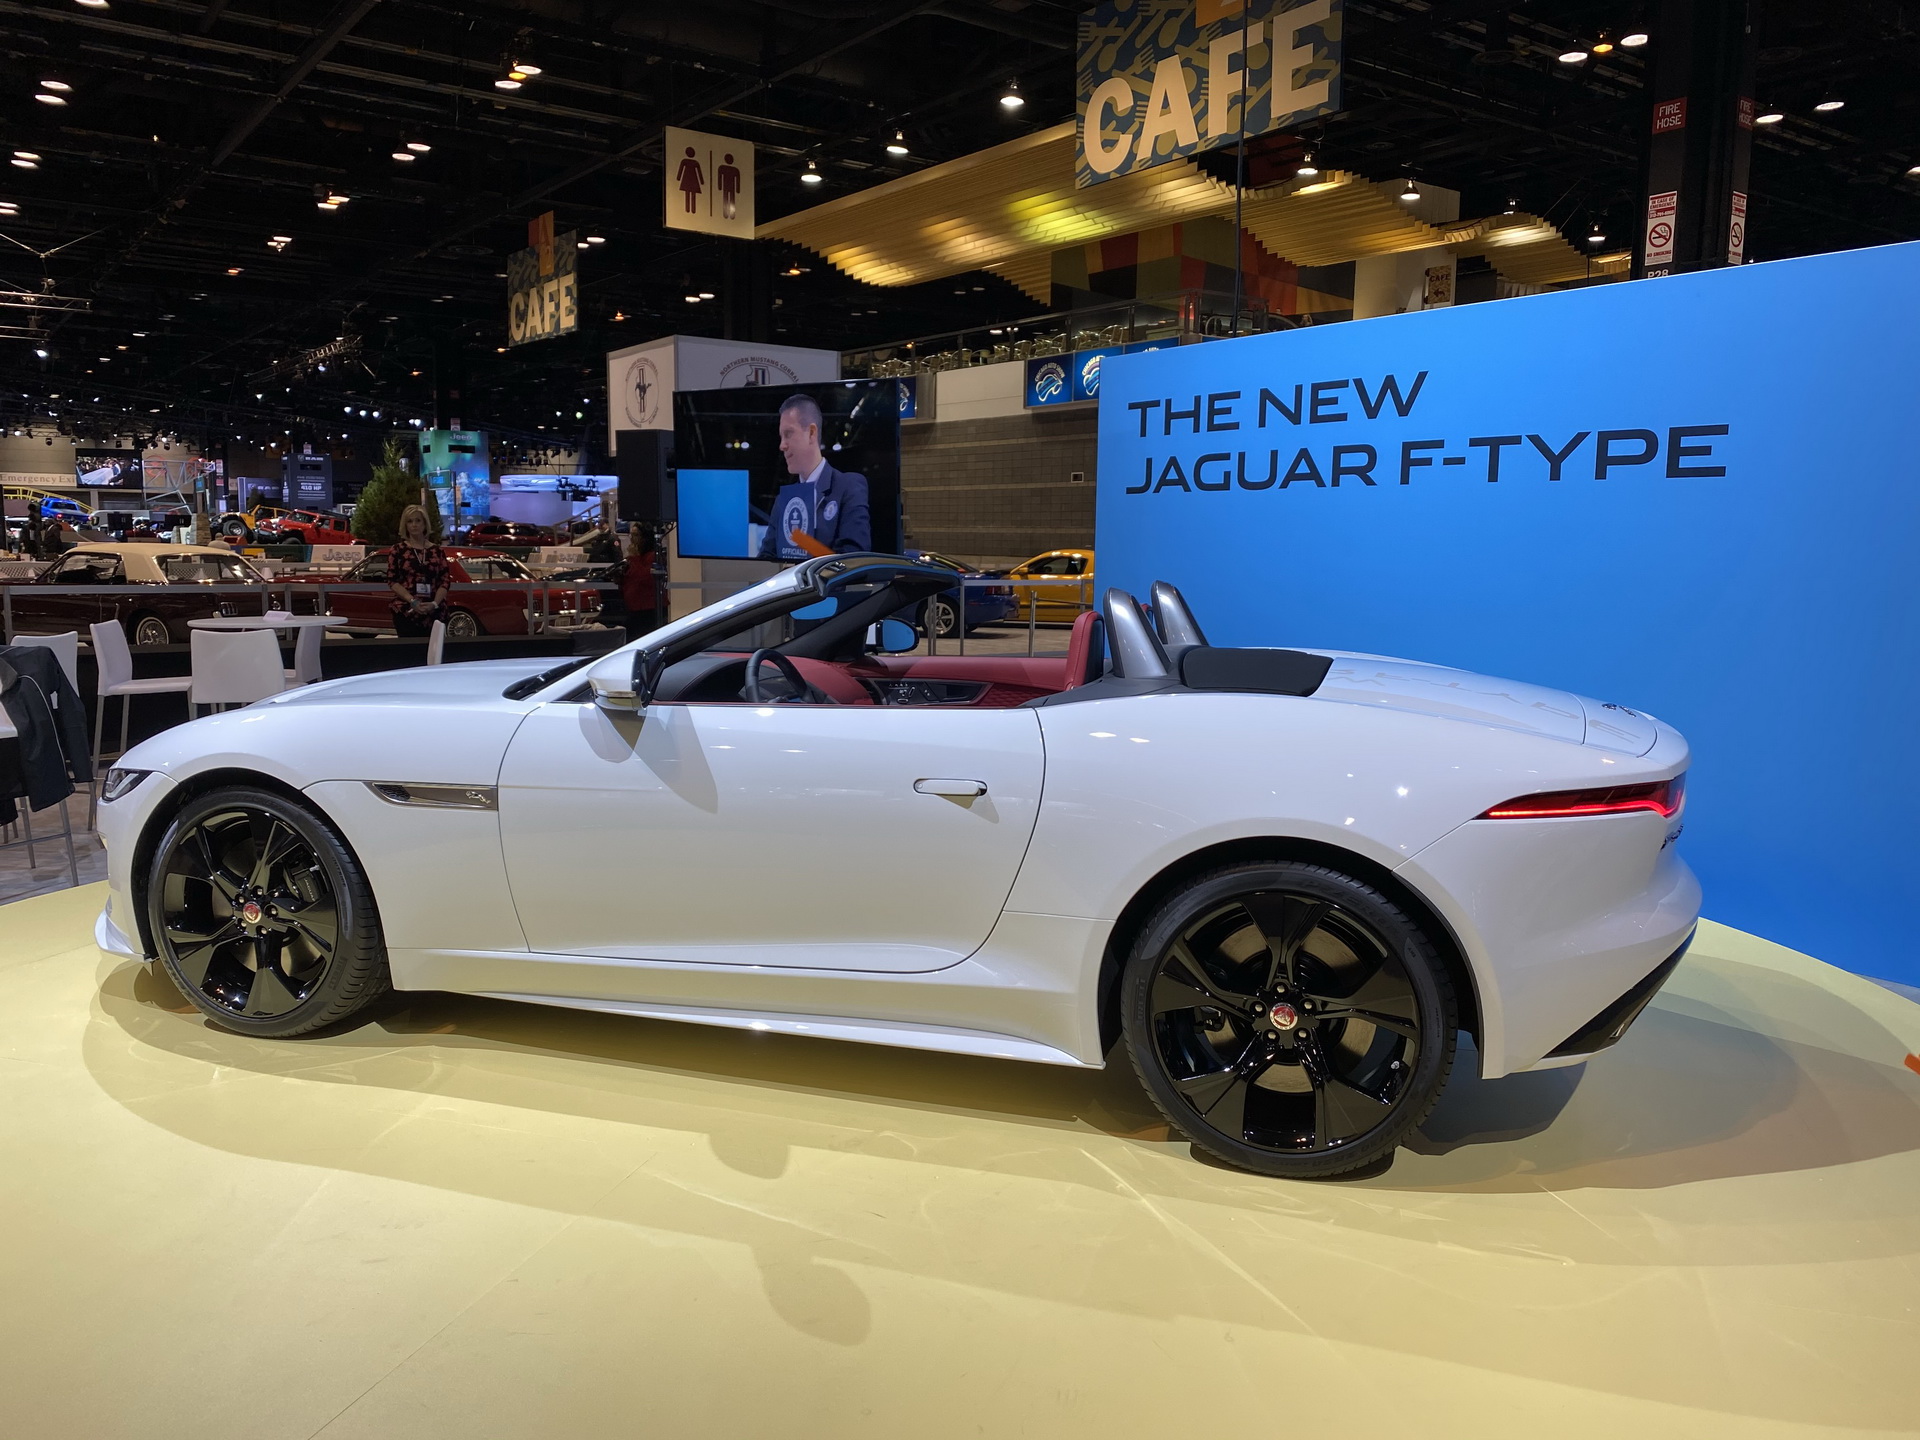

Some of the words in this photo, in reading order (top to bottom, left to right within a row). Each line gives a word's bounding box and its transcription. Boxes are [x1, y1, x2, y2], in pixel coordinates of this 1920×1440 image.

[1083, 0, 1331, 174] CAFE
[1658, 102, 1681, 117] FIRE
[1656, 114, 1682, 130] HOSE
[1650, 200, 1675, 209] EMERGENCY
[510, 272, 575, 342] CAFE
[719, 357, 749, 377] NORTHERN
[750, 356, 779, 367] MUSTANG
[1126, 389, 1242, 438] THE
[1257, 370, 1430, 429] NEW
[1124, 442, 1379, 496] JAGUAR
[1398, 423, 1731, 487] F-TYPE
[0, 473, 57, 485] Emergency
[59, 474, 76, 483] Exi
[322, 548, 362, 563] Jeep
